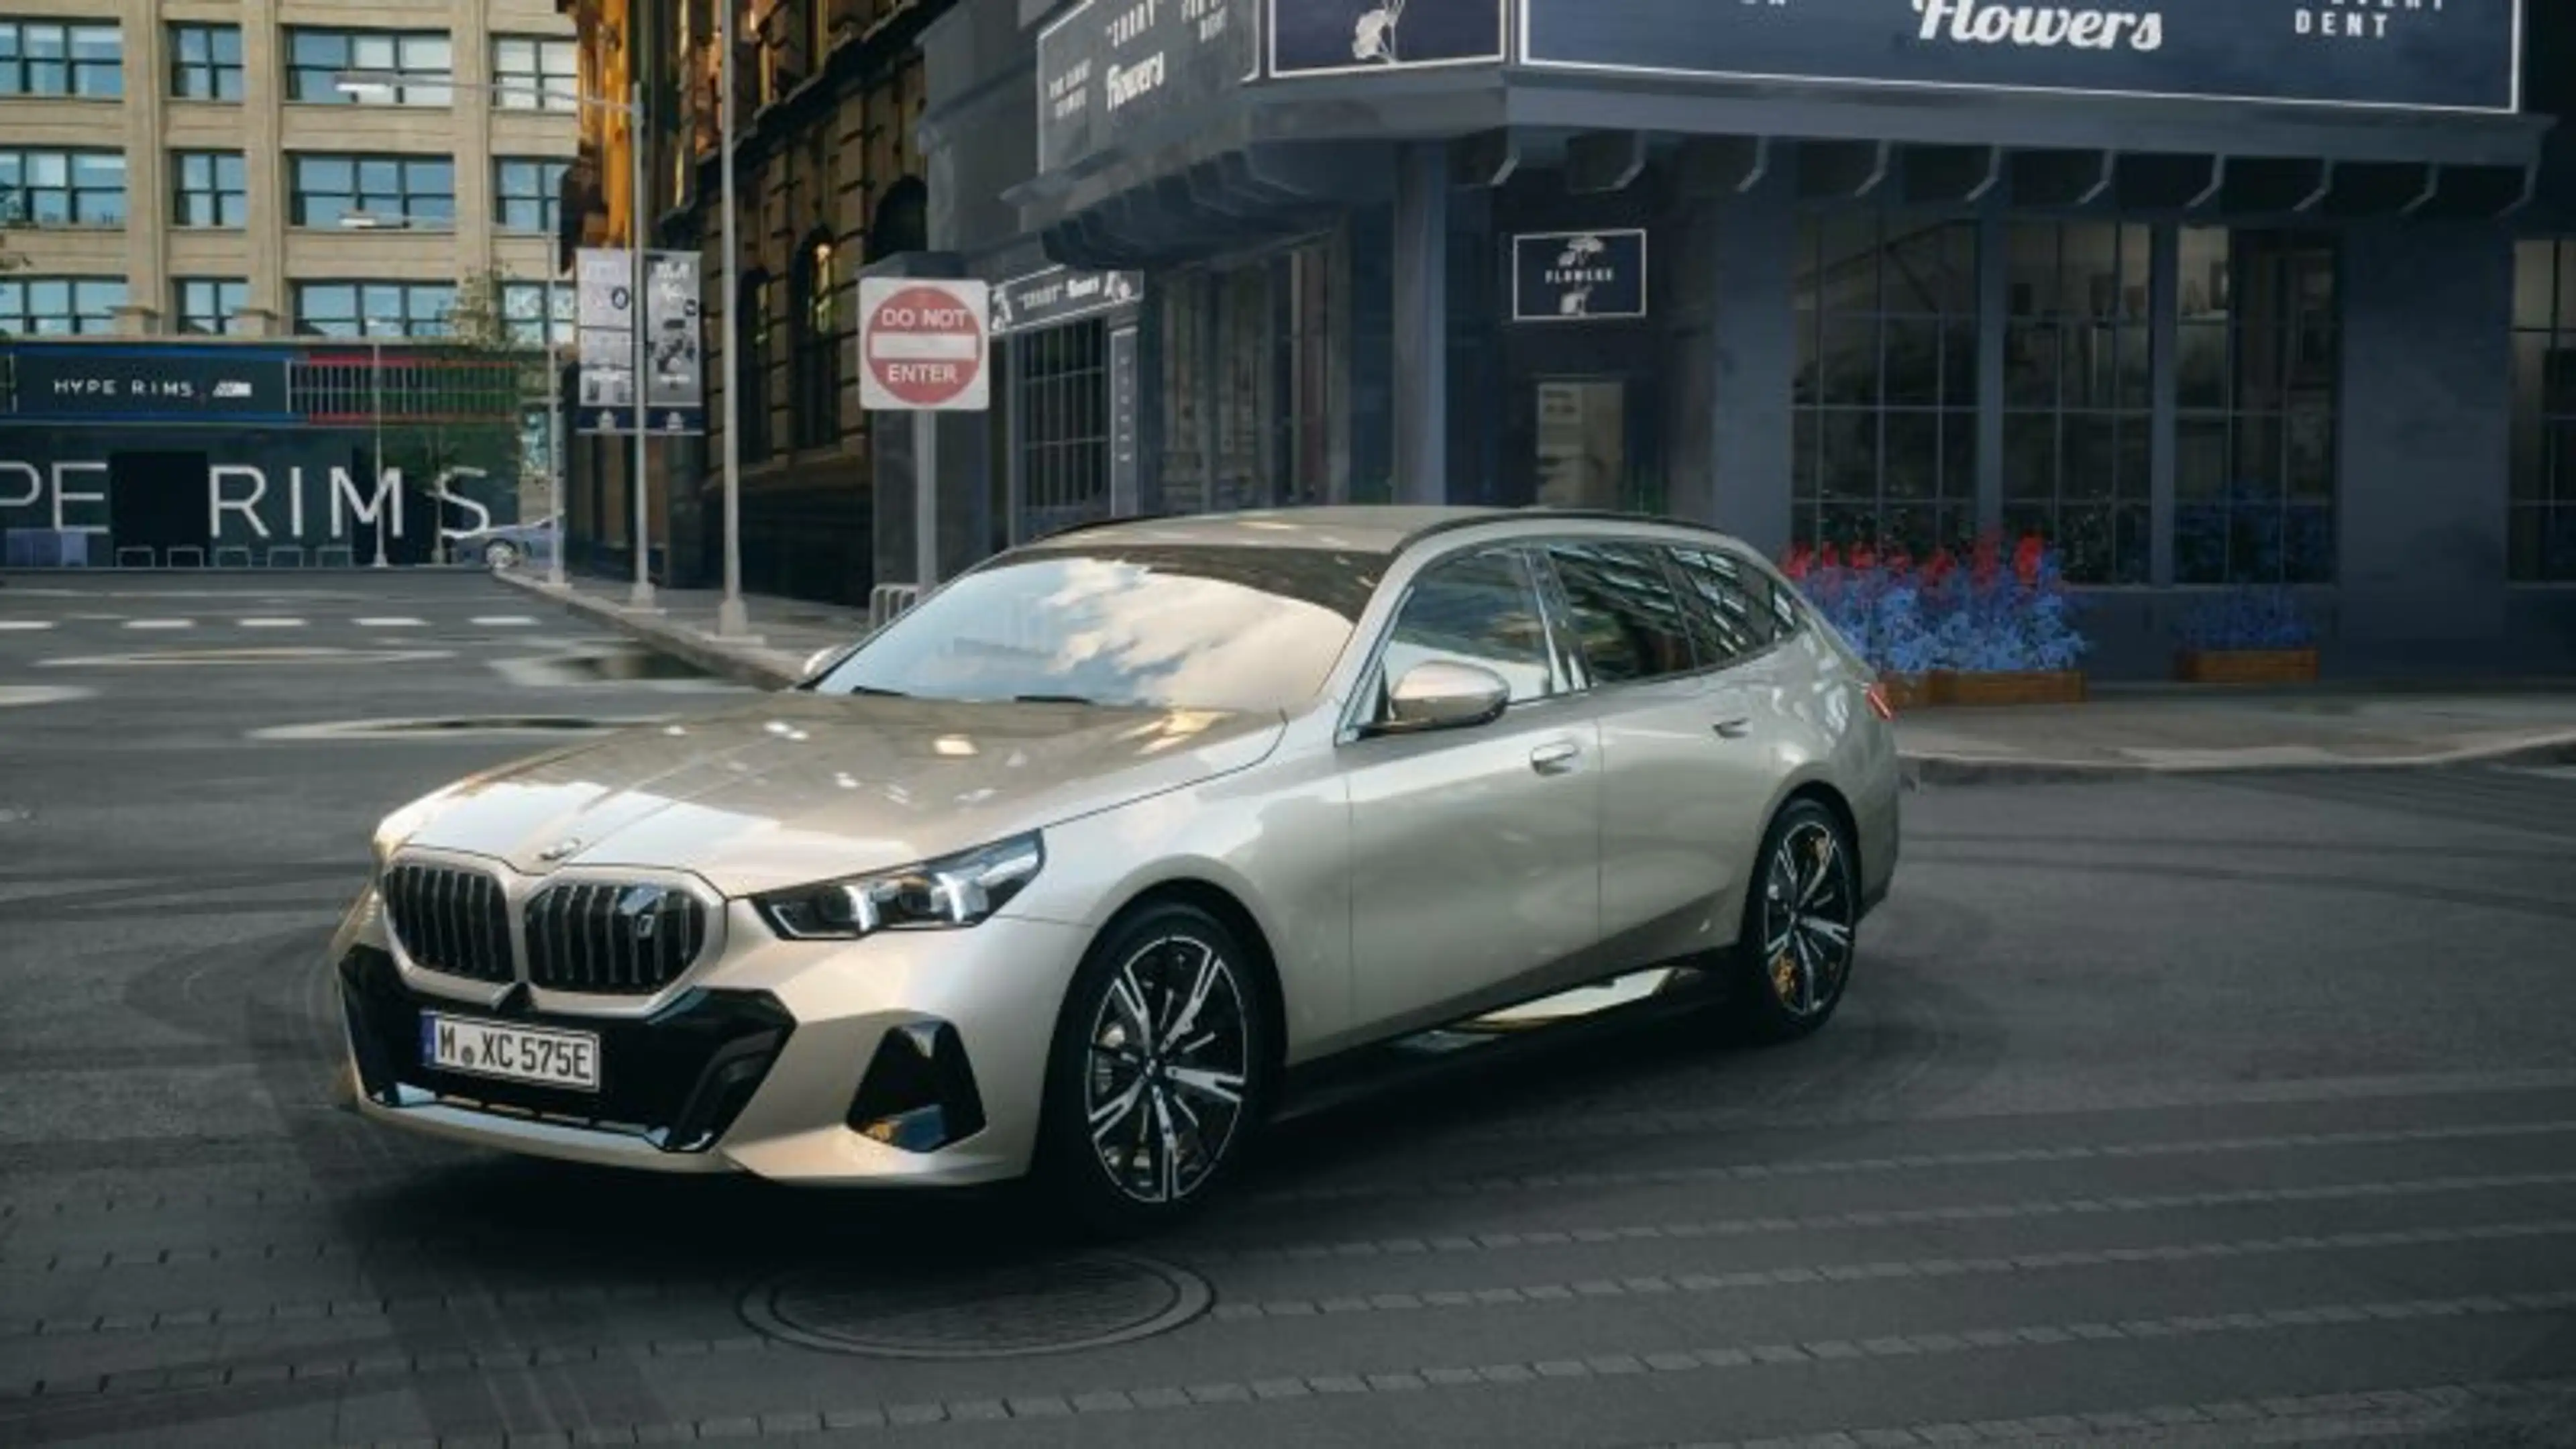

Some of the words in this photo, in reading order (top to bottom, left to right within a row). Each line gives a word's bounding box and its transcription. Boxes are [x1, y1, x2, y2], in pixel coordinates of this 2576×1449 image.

[2294, 8, 2388, 38] DENT
[881, 308, 916, 327] DO
[922, 309, 967, 329] NOT
[888, 364, 958, 384] ENTER
[53, 379, 117, 396] HYPE
[131, 379, 195, 396] RIMS
[209, 465, 490, 537] RIMS
[440, 1024, 456, 1060] M
[480, 1030, 514, 1068] XC
[520, 1036, 590, 1080] 575E
